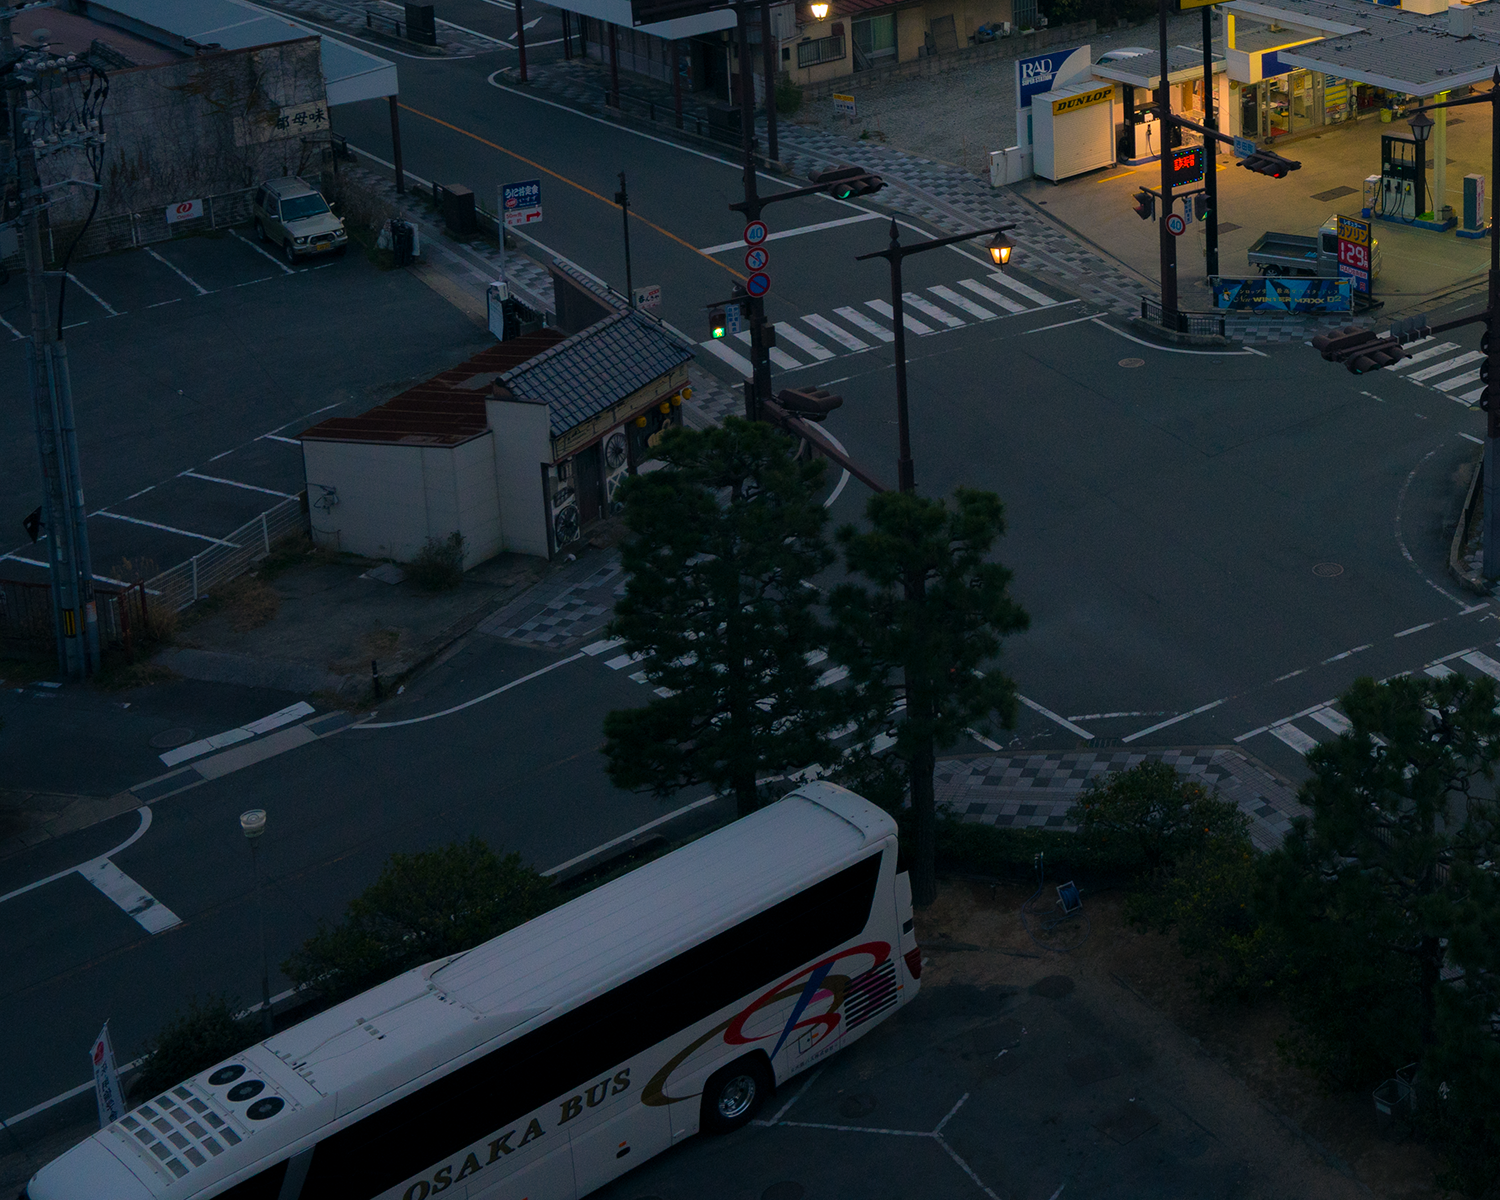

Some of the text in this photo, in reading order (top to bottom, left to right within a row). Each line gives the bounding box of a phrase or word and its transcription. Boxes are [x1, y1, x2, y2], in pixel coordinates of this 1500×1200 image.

[1021, 58, 1052, 78] RAD
[1057, 89, 1111, 111] DUNLOP
[749, 227, 763, 240] 40
[1170, 219, 1182, 231] 40
[1339, 225, 1368, 243] ガソリン
[1341, 242, 1364, 266] 129
[1295, 296, 1324, 304] MAXX
[402, 1068, 630, 1200] OSAKA BUS
